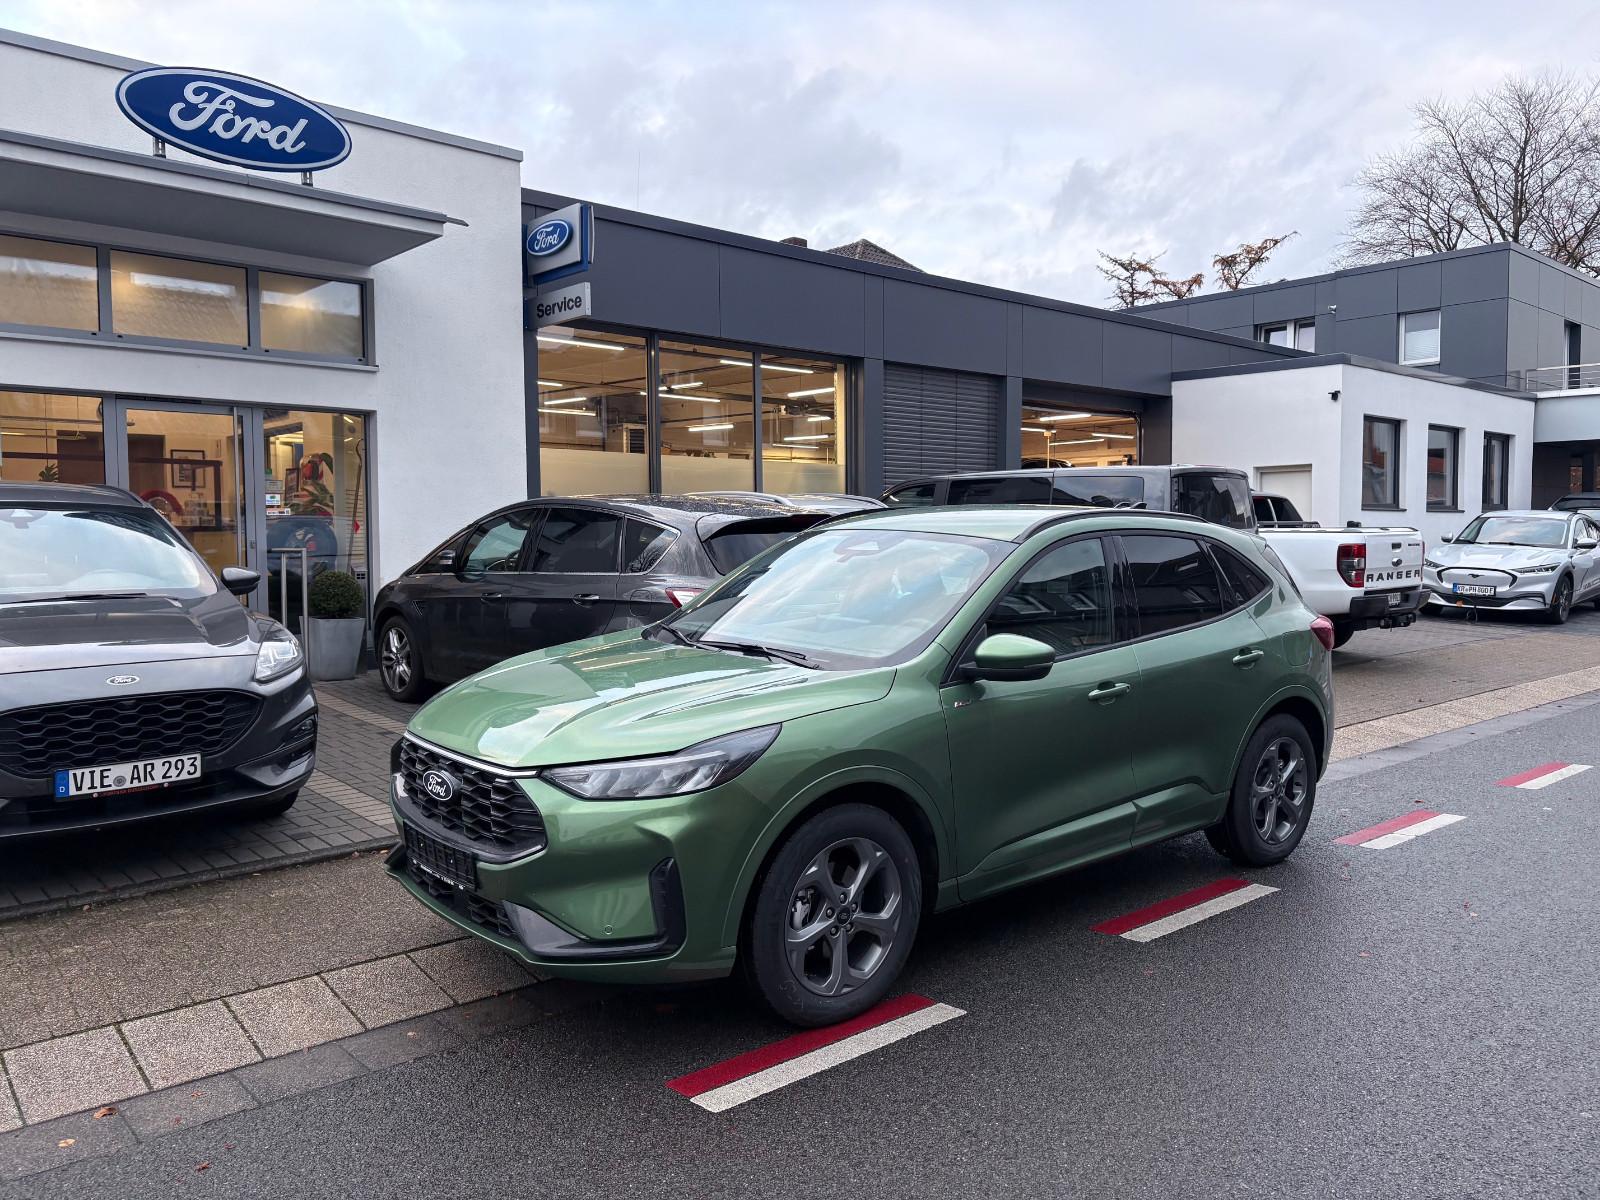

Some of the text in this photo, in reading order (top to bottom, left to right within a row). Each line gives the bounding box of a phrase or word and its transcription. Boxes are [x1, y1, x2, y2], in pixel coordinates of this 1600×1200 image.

[169, 81, 307, 153] Ford
[534, 225, 560, 251] Ford
[536, 296, 583, 318] Service
[1366, 570, 1421, 583] RANGER
[72, 768, 113, 792] VIE
[129, 762, 156, 785] AR
[161, 756, 198, 780] 293
[427, 774, 447, 797] Ford
